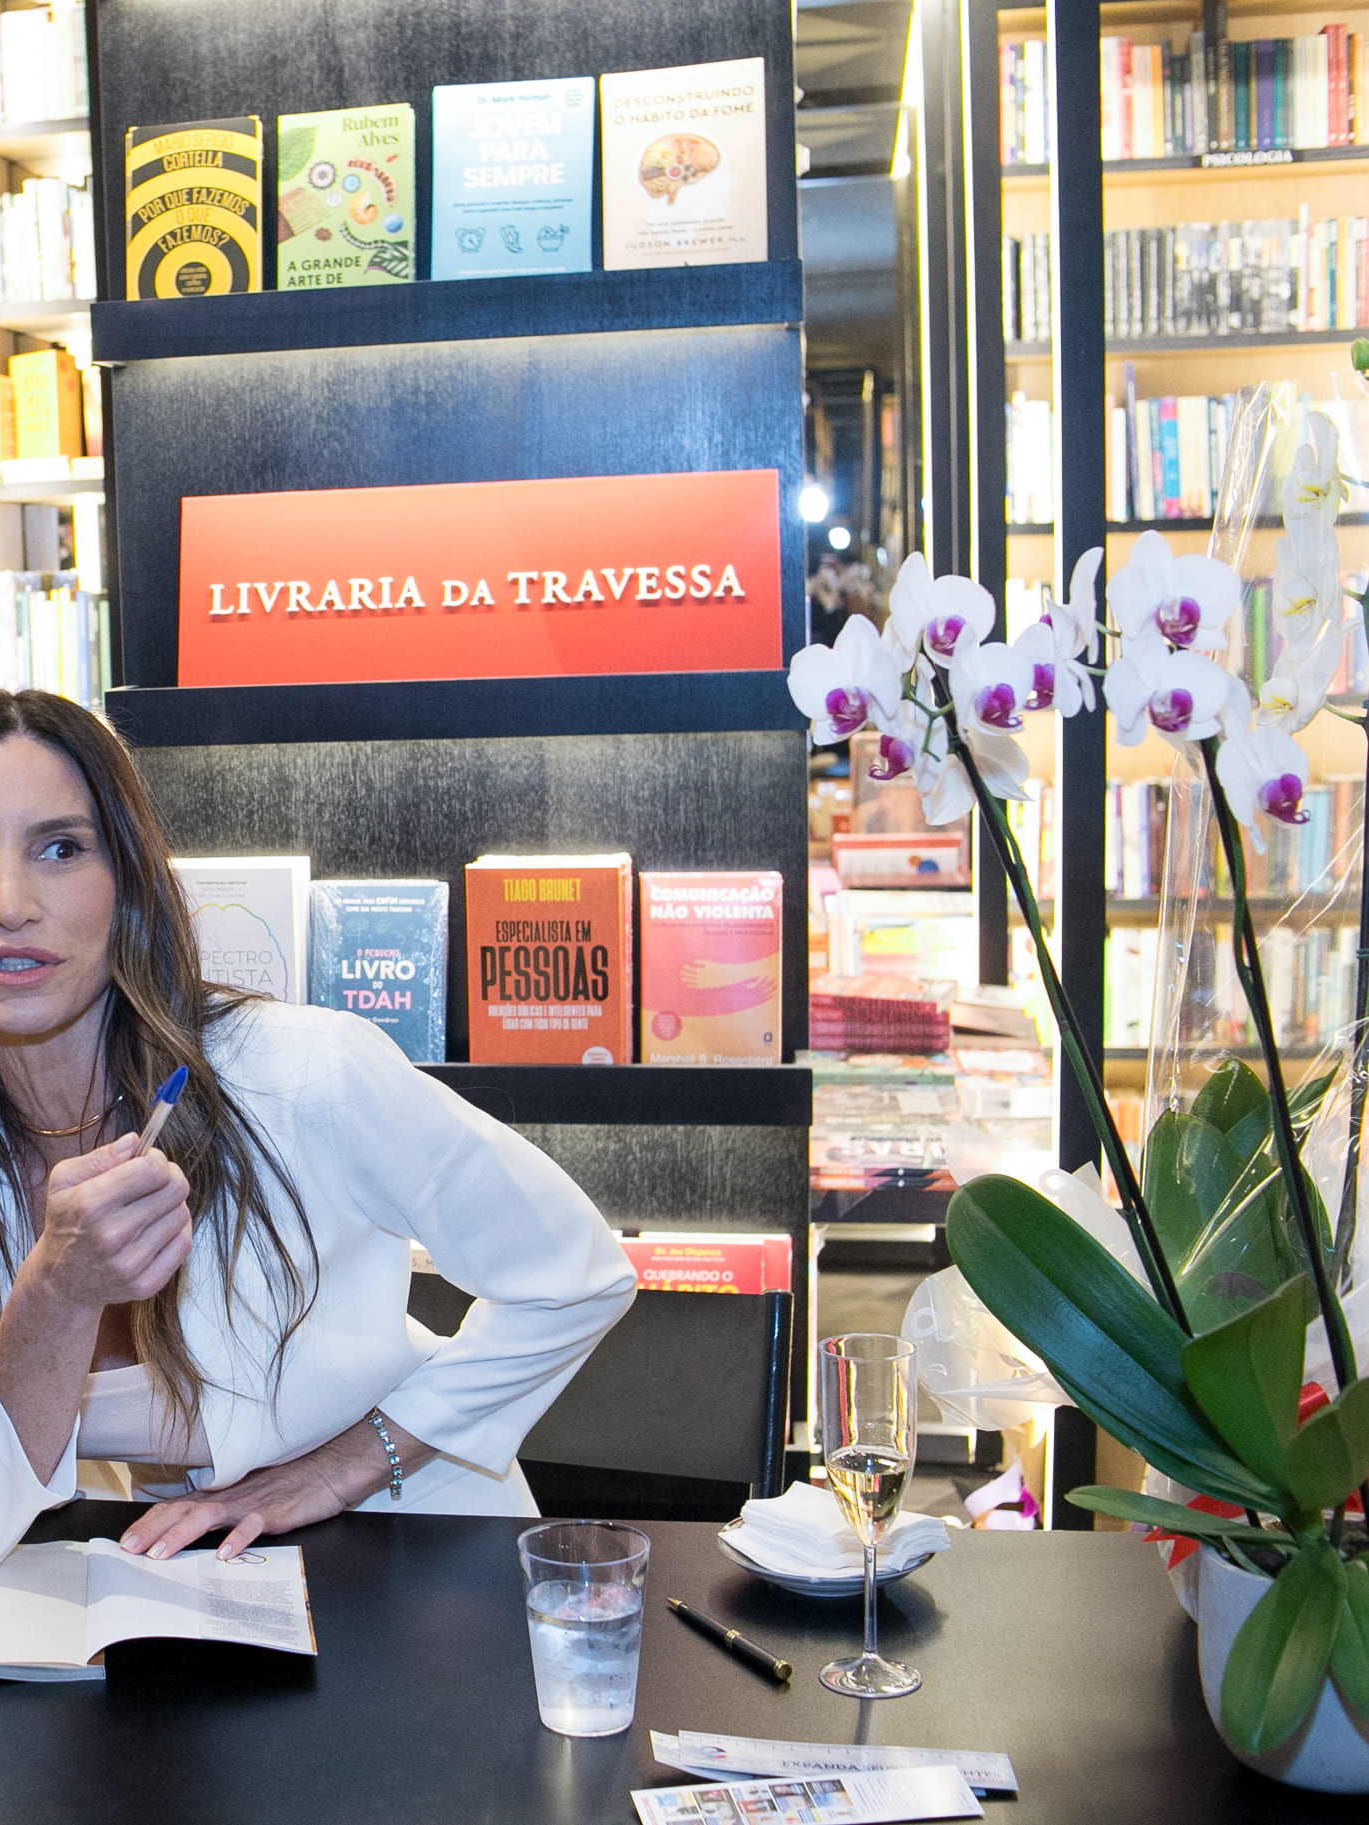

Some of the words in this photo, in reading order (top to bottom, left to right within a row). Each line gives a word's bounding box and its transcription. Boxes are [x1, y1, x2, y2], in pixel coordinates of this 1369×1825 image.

[614, 85, 755, 109] DESCONSTRUINDO
[343, 114, 399, 131] Rubem
[614, 115, 626, 126] O
[690, 107, 709, 119] DA
[714, 102, 755, 116] FOME
[467, 111, 563, 139] JOVEM
[359, 131, 399, 147] Alves
[162, 150, 223, 171] CORTELLA
[480, 139, 548, 164] PARA
[1201, 149, 1294, 169] PSICOLOGIA
[463, 163, 565, 189] SEMPRE
[137, 198, 166, 223] POR
[164, 187, 191, 207] QUE
[192, 187, 250, 216] FAZEMOS
[175, 208, 184, 225] O
[187, 207, 213, 223] QUE
[157, 224, 230, 254] FAZEMOS?
[287, 261, 298, 272] A
[301, 255, 362, 272] GRANDE
[287, 274, 323, 288] ARTE
[326, 272, 344, 285] DE
[209, 576, 425, 616] LIVRARIA
[442, 580, 495, 607] DA
[508, 564, 746, 605] TRAVESSA
[503, 878, 536, 902] TIAGO
[540, 877, 581, 901] BRUNET
[650, 885, 775, 904] COMUNICAÇÃO
[650, 903, 689, 919] NÃO
[693, 905, 775, 919] VIOLENTA
[495, 920, 572, 944] ESPECIALISTA
[575, 920, 592, 942] EM
[200, 950, 273, 965] PECTRO
[207, 969, 274, 986] TISTA
[341, 959, 416, 980] LIVRO
[480, 945, 609, 1001] PESSOAS
[372, 981, 383, 989] DO
[342, 990, 412, 1010] TDAH
[643, 1269, 721, 1282] QUEBRANDO
[722, 1270, 734, 1283] O
[782, 1760, 860, 1772] EXPANDA
